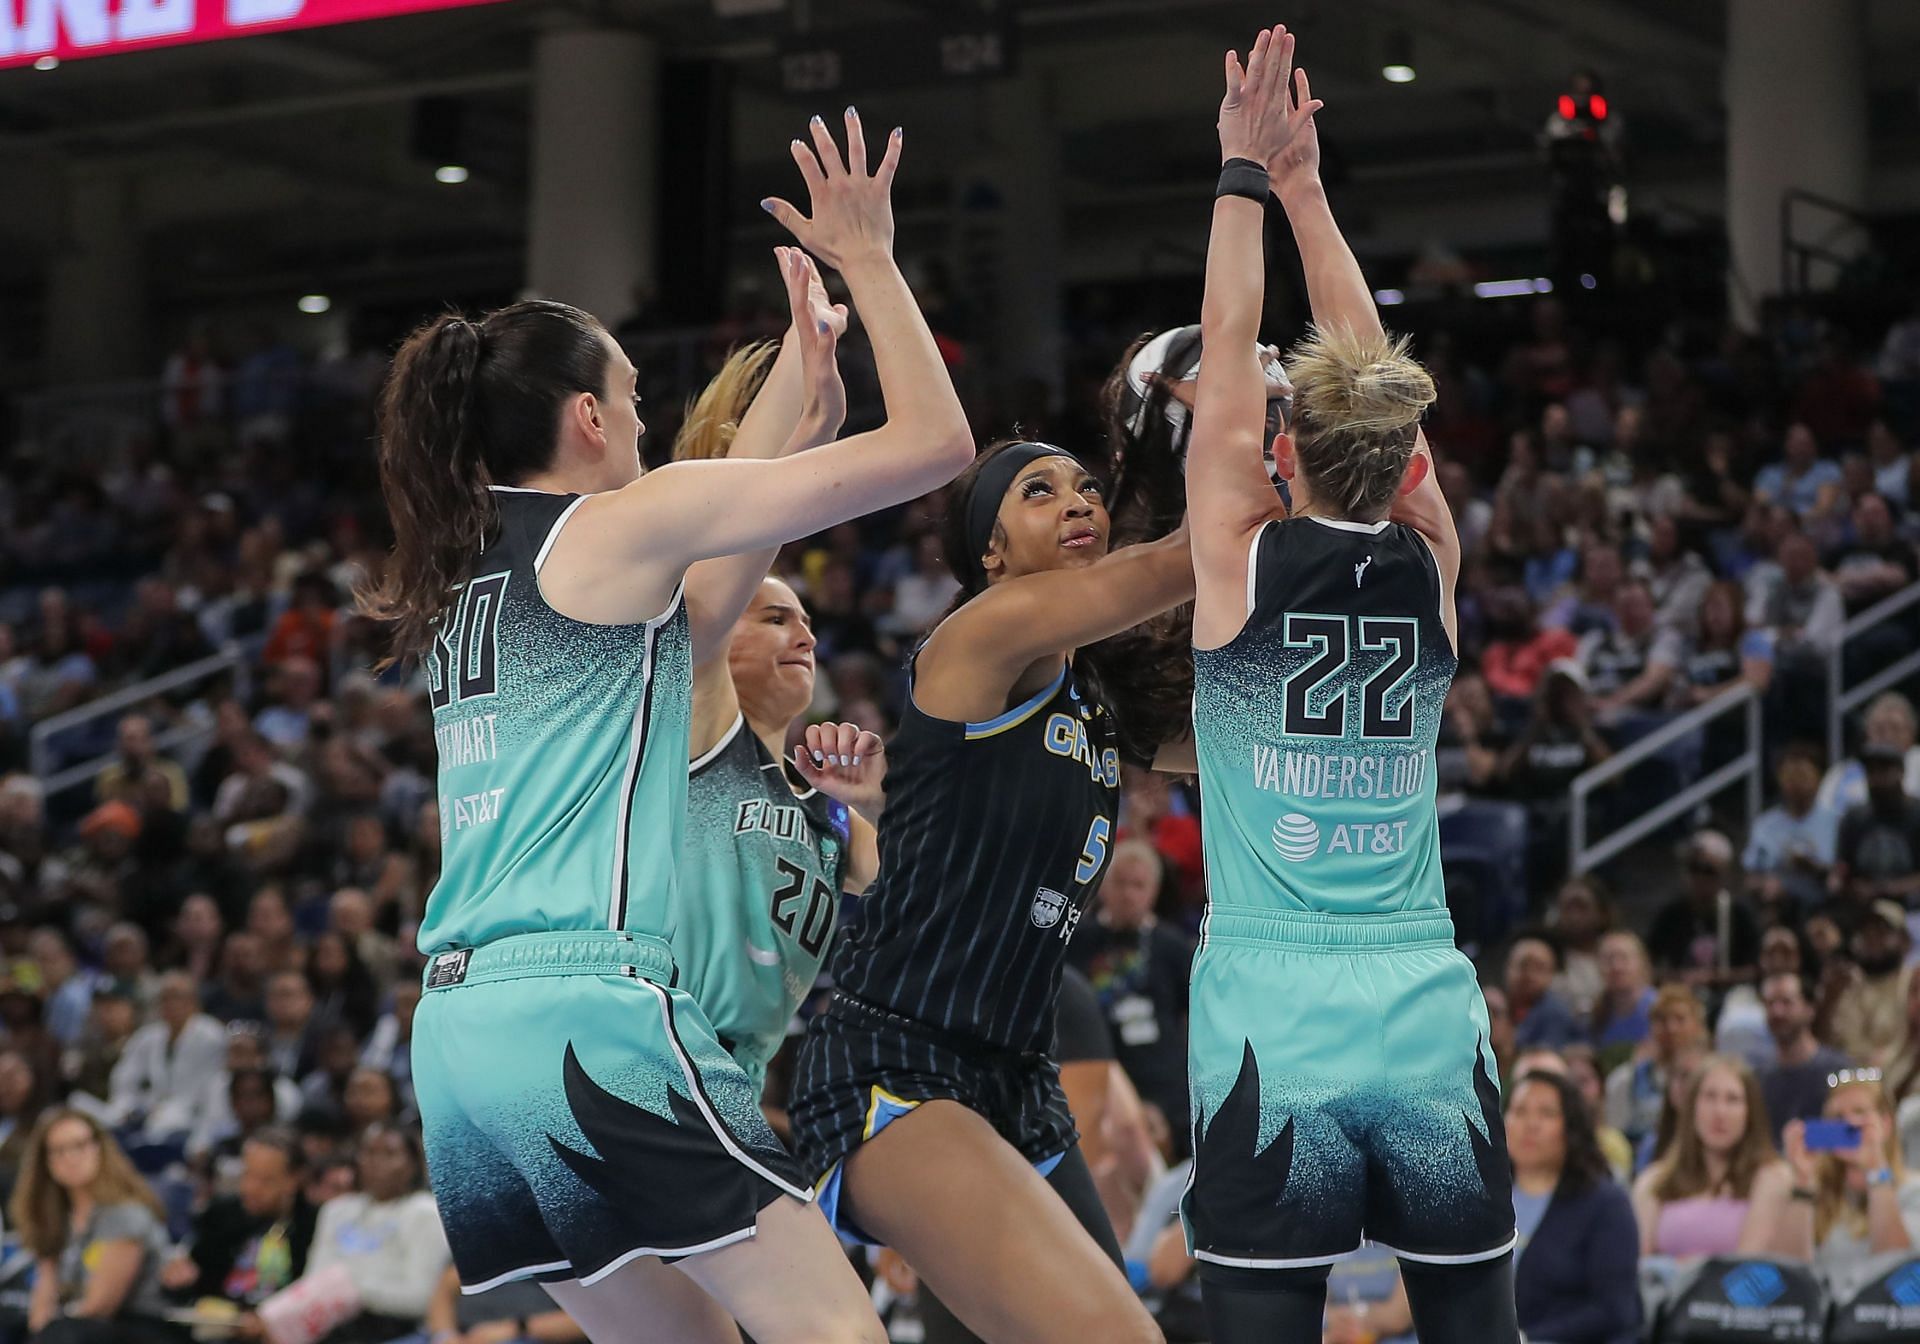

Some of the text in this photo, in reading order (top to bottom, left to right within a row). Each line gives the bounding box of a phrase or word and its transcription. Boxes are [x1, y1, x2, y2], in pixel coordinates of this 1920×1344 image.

[1282, 612, 1420, 741] 22
[1253, 745, 1428, 799] VANDERSLOOT
[454, 787, 505, 831] AT&T
[1326, 820, 1408, 854] AT&T
[1074, 814, 1111, 885] 5
[768, 854, 835, 960] 20
